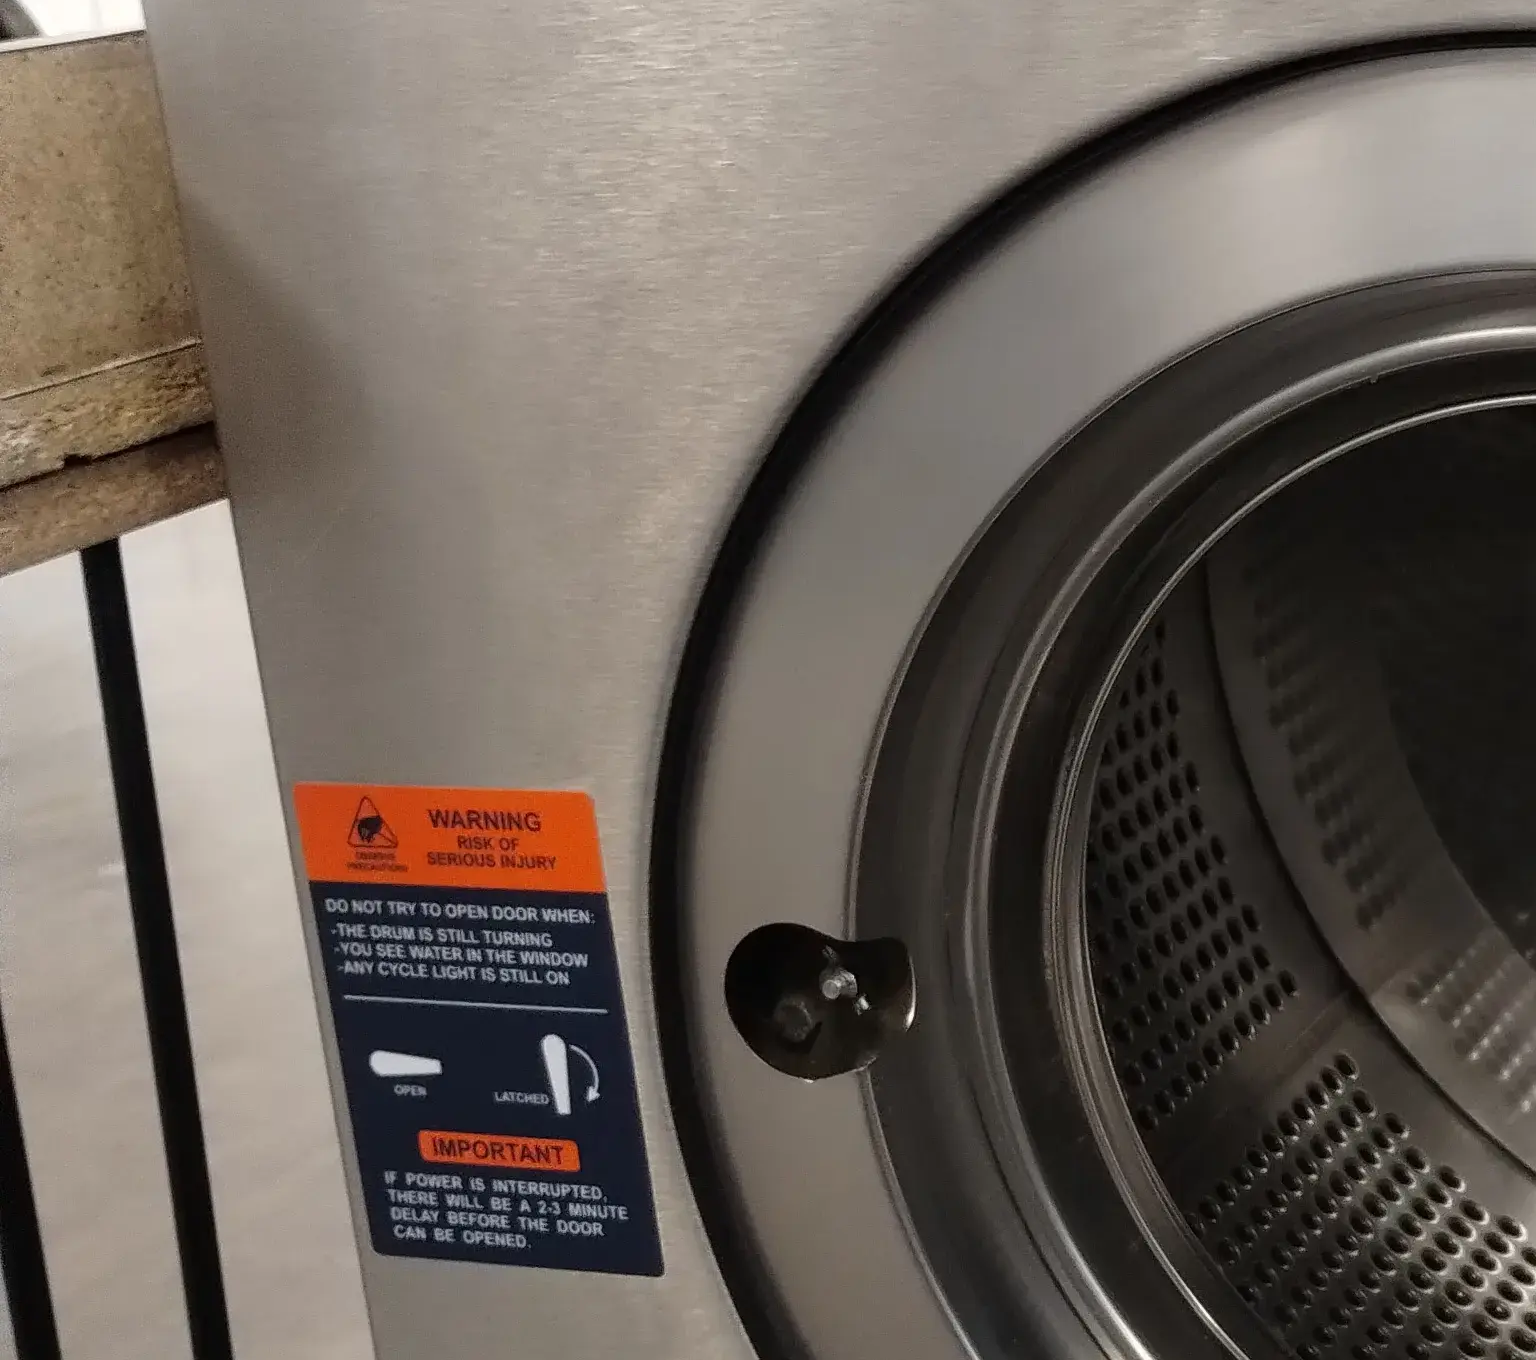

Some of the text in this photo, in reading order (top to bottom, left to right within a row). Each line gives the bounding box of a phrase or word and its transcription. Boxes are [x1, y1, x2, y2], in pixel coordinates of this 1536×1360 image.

[428, 809, 541, 832] WARNING
[457, 835, 519, 851] RISK OF
[427, 852, 556, 869] SERIOUS INJURY
[325, 898, 595, 924] DO NOT TRY TO OPEN DOOR WHEN:
[331, 922, 552, 947] -THE DRUM IS STILL TURNING
[334, 942, 588, 968] -YOU SEE WATER IN THE WINDOW
[338, 960, 570, 985] -ANY CYCLE LIGHT IS STILL ON
[393, 1084, 427, 1096] OPEN
[494, 1091, 549, 1105] LATCHED
[431, 1137, 563, 1164] IMPORTANT
[384, 1171, 607, 1203] IF POWER IS INTERRUPTED,
[386, 1189, 629, 1220] THERE WILL BE A 2-3 MINUTE
[390, 1207, 605, 1236] DELAY BEFORE THE DOOR
[393, 1224, 531, 1248] CAN BE OPENED.
